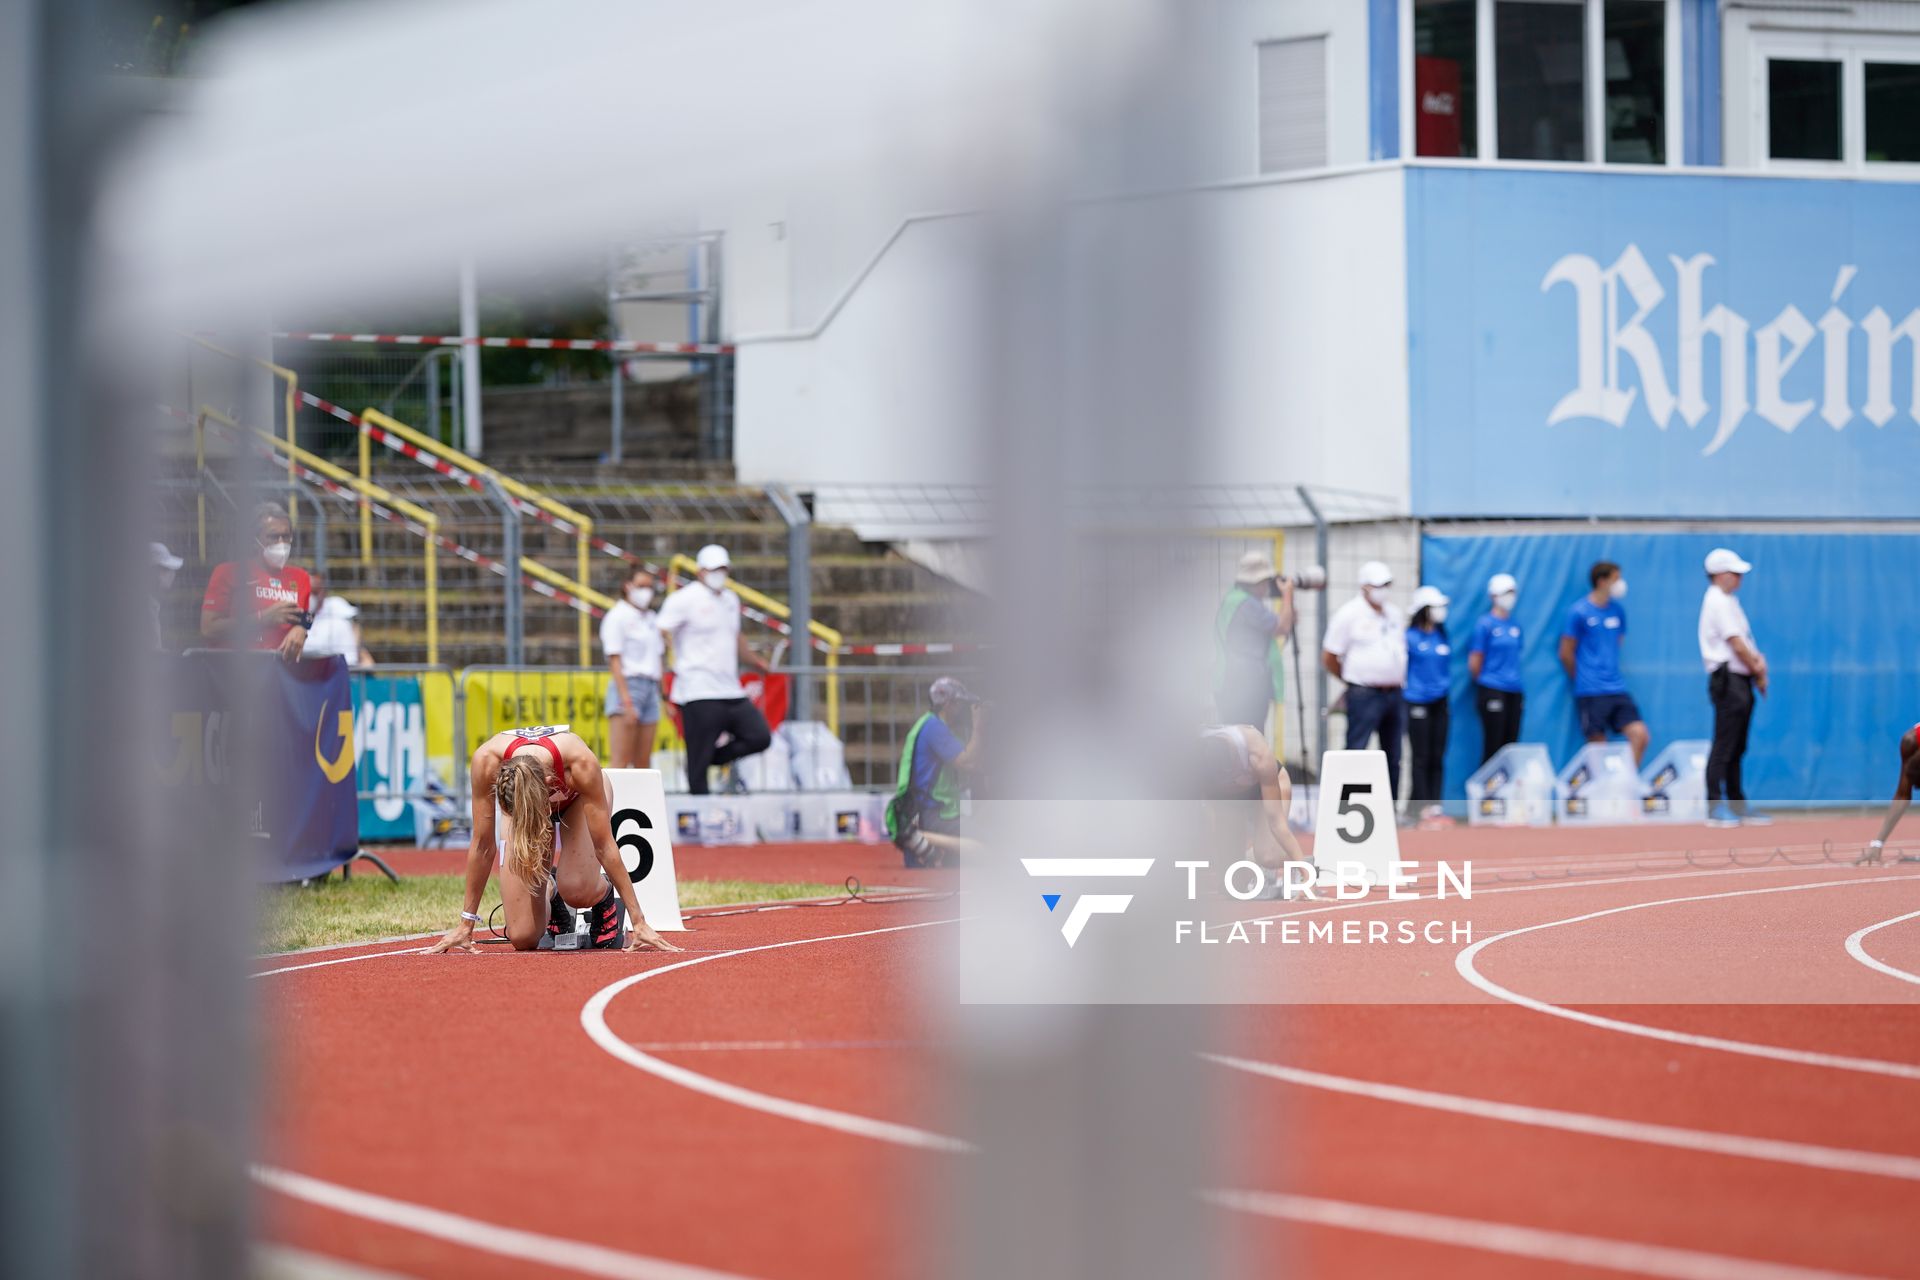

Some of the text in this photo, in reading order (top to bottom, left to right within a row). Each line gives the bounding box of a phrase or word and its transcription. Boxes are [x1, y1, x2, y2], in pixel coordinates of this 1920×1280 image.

[1541, 243, 1920, 456] Rhein
[256, 587, 298, 604] GERMANY
[611, 808, 654, 884] 6
[1336, 783, 1375, 844] 5
